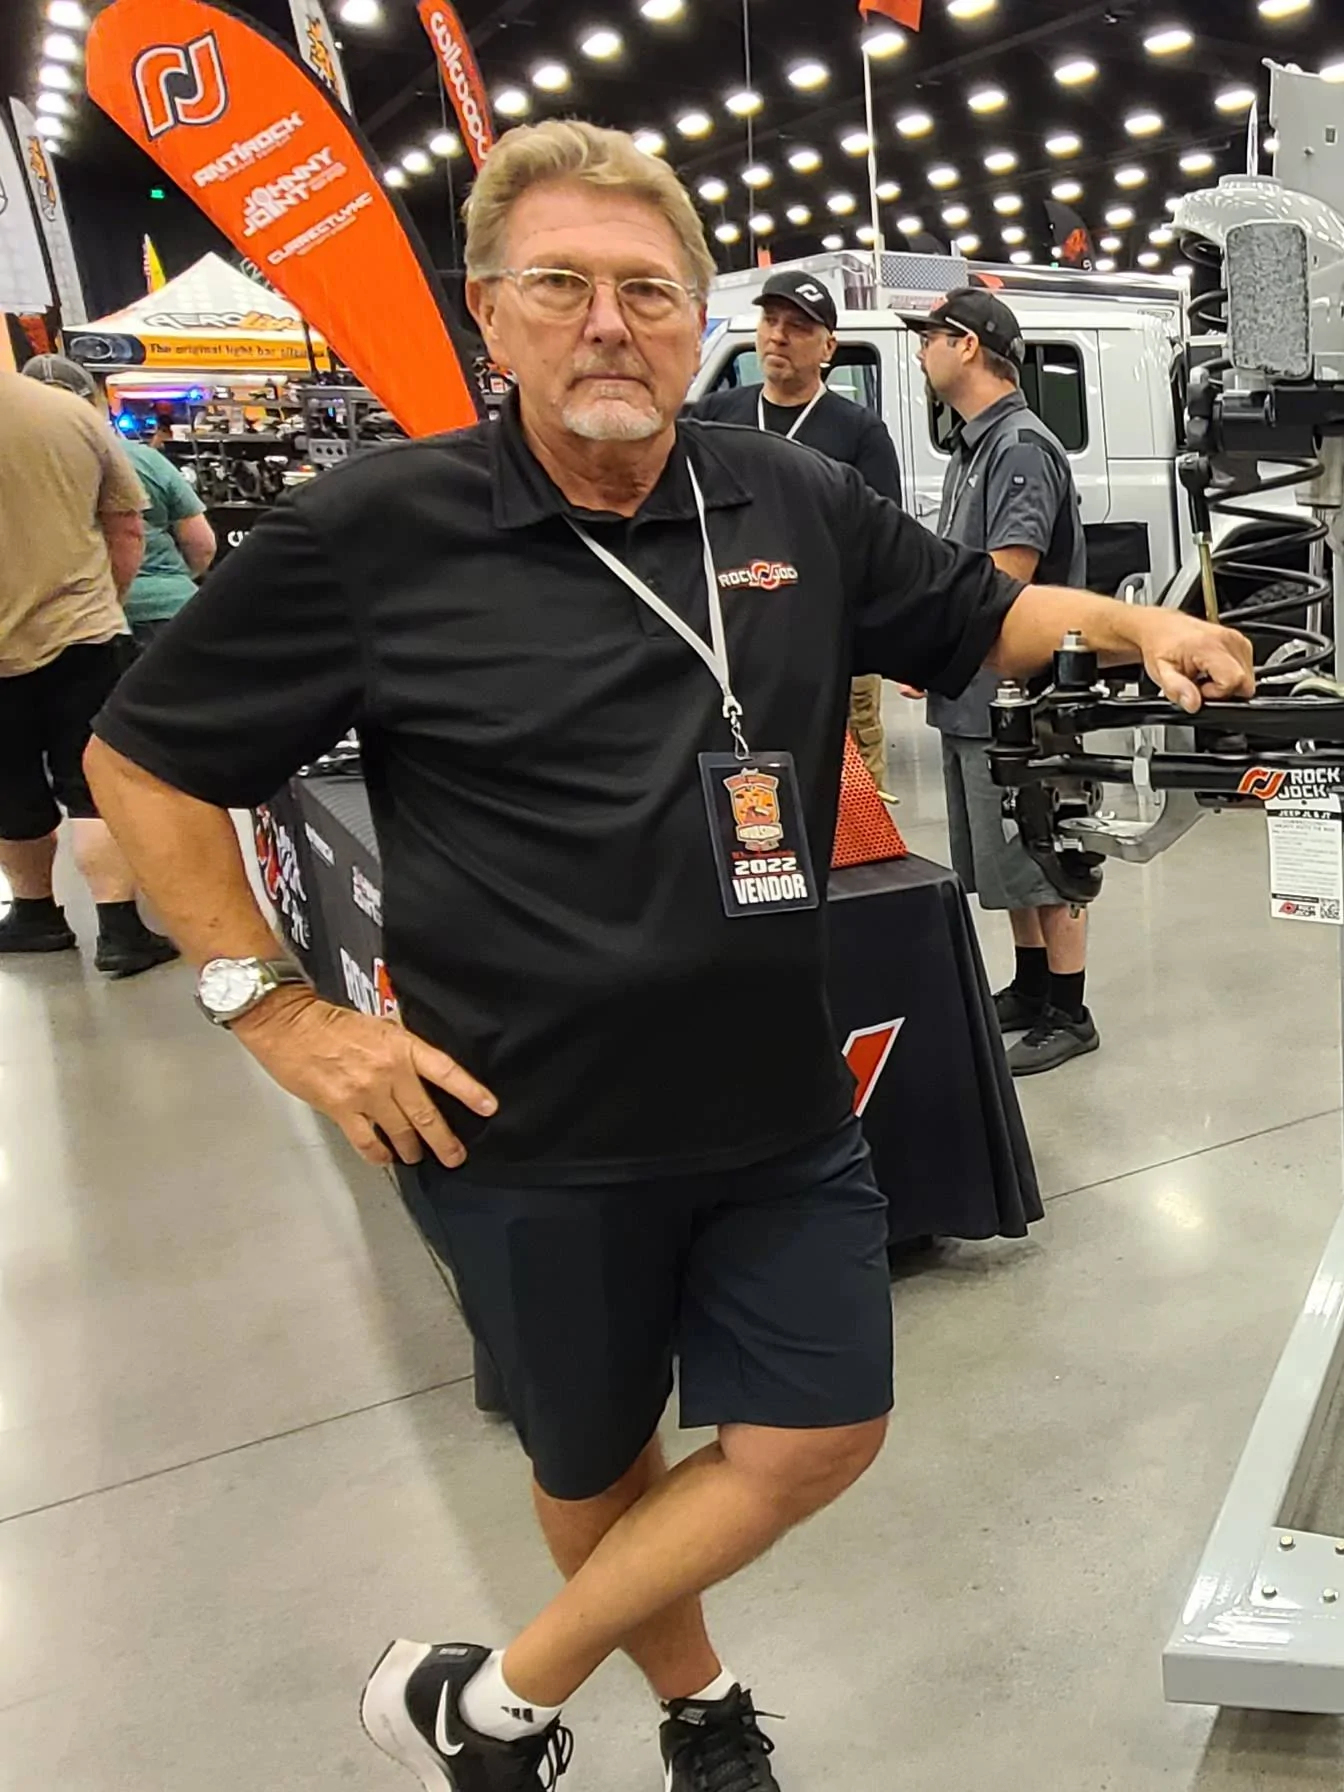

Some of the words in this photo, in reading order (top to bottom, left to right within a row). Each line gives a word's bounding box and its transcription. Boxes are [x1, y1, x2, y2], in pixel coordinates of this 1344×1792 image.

[244, 146, 333, 216] JOHNNY
[1290, 767, 1341, 785] ROCK
[1278, 784, 1327, 799] JOCK
[734, 857, 797, 876] 2022
[732, 873, 808, 906] VENDOR
